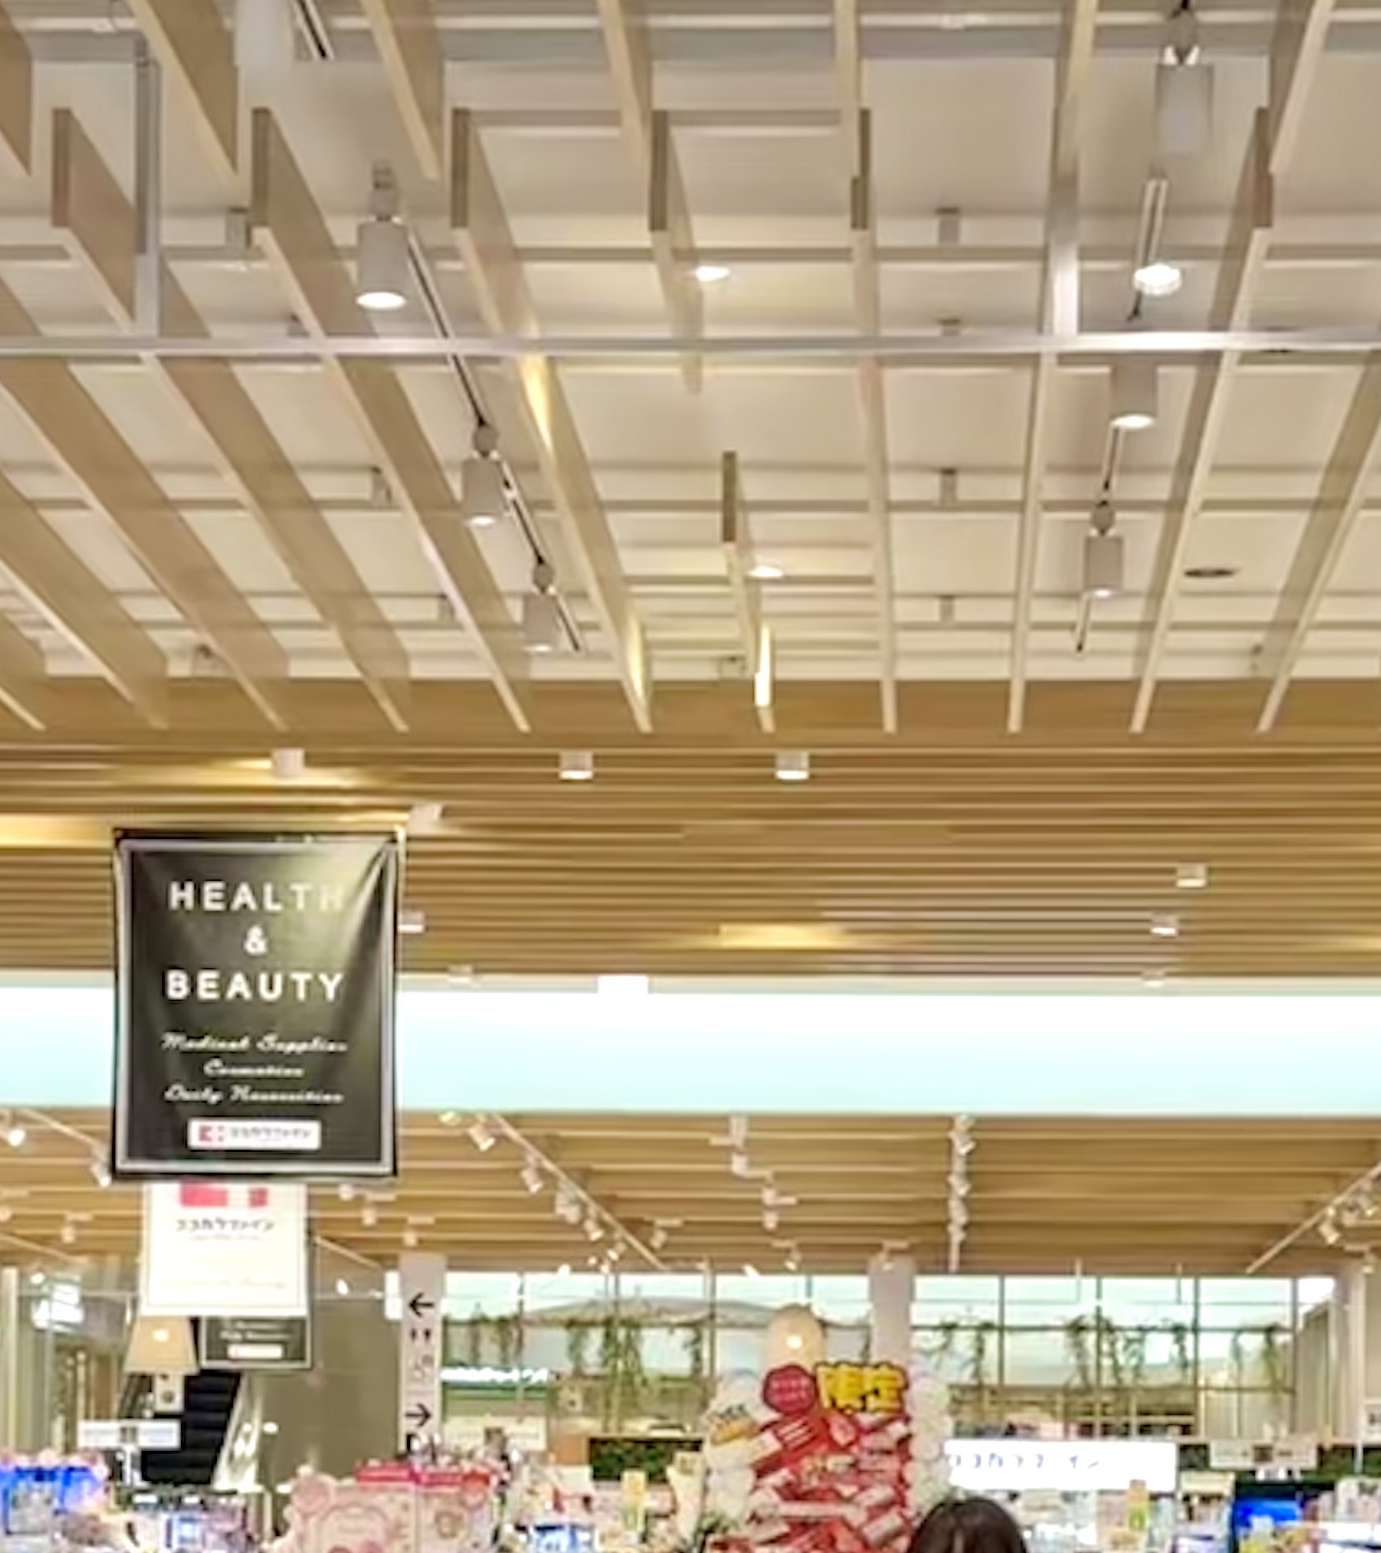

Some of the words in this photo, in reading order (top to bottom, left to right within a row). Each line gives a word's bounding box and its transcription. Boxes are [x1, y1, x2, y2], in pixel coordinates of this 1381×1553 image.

[169, 880, 345, 911] HEALTH
[244, 924, 267, 955] &
[166, 969, 343, 1000] BEAUTY
